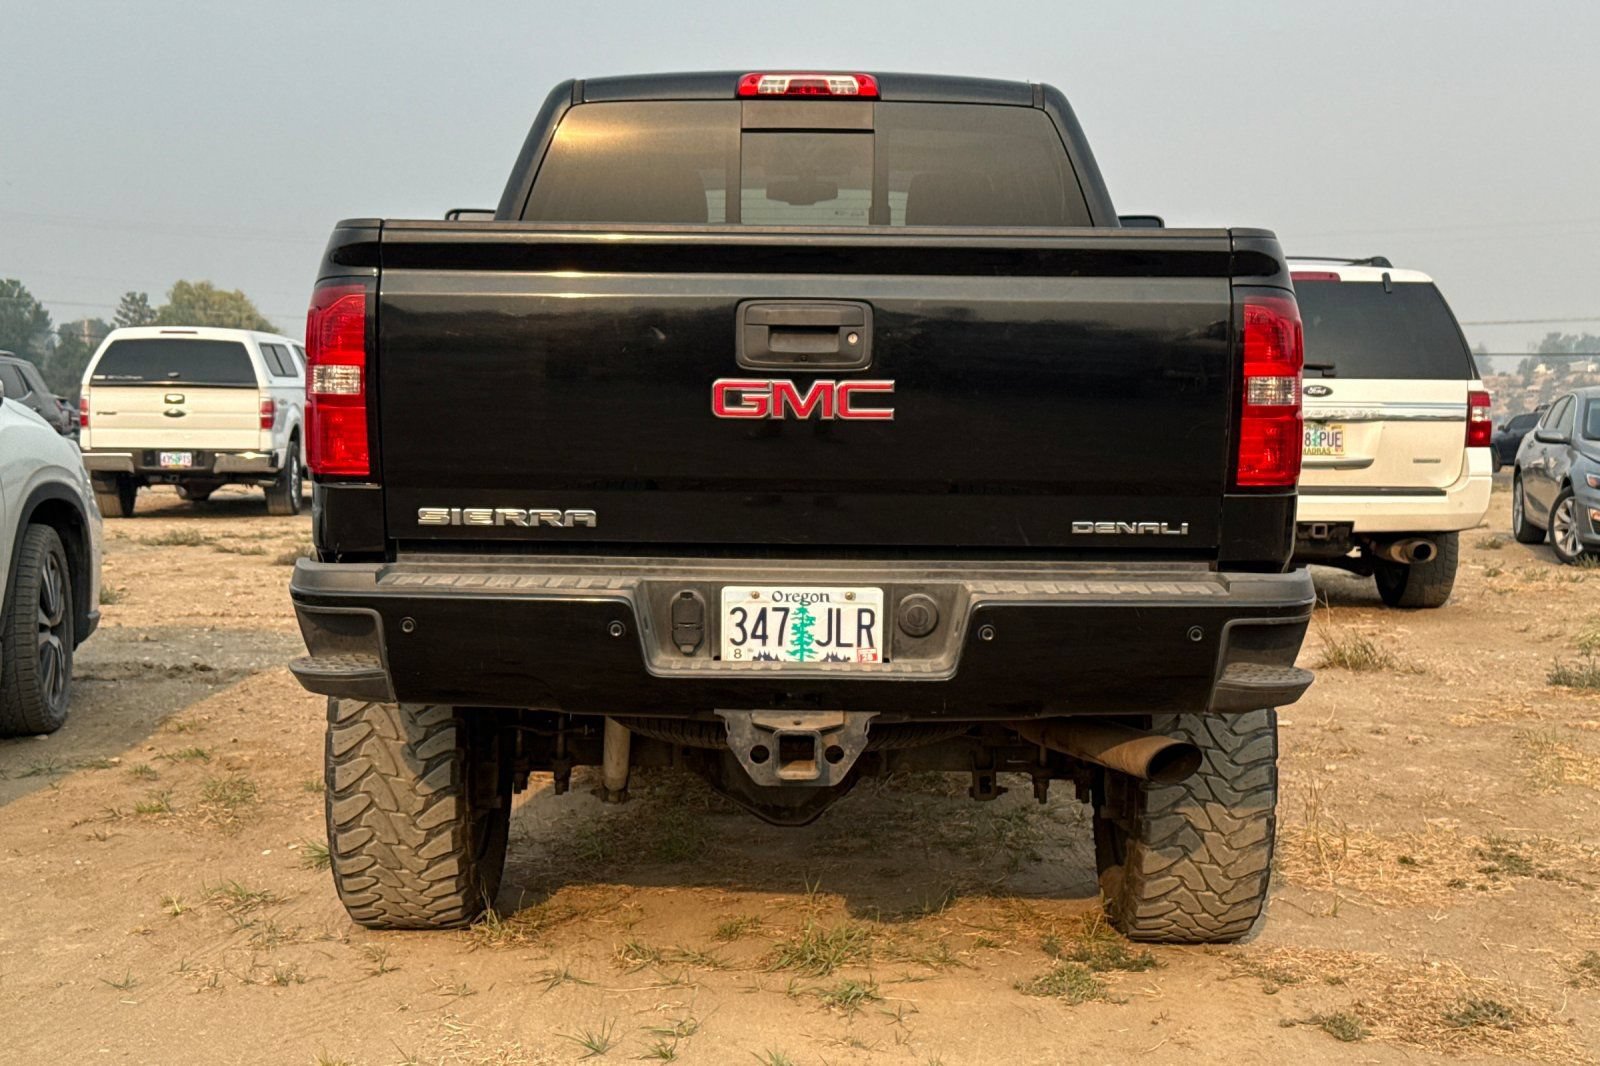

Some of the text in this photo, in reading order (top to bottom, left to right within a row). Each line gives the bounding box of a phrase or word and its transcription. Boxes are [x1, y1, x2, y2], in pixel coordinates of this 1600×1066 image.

[712, 378, 895, 420] GMC
[1319, 431, 1343, 448] PUE
[418, 507, 597, 527] SIERRA
[1071, 521, 1189, 535] DENALI
[771, 590, 831, 606] Oregon
[729, 606, 876, 648] 347 JLR
[733, 648, 742, 659] 8
